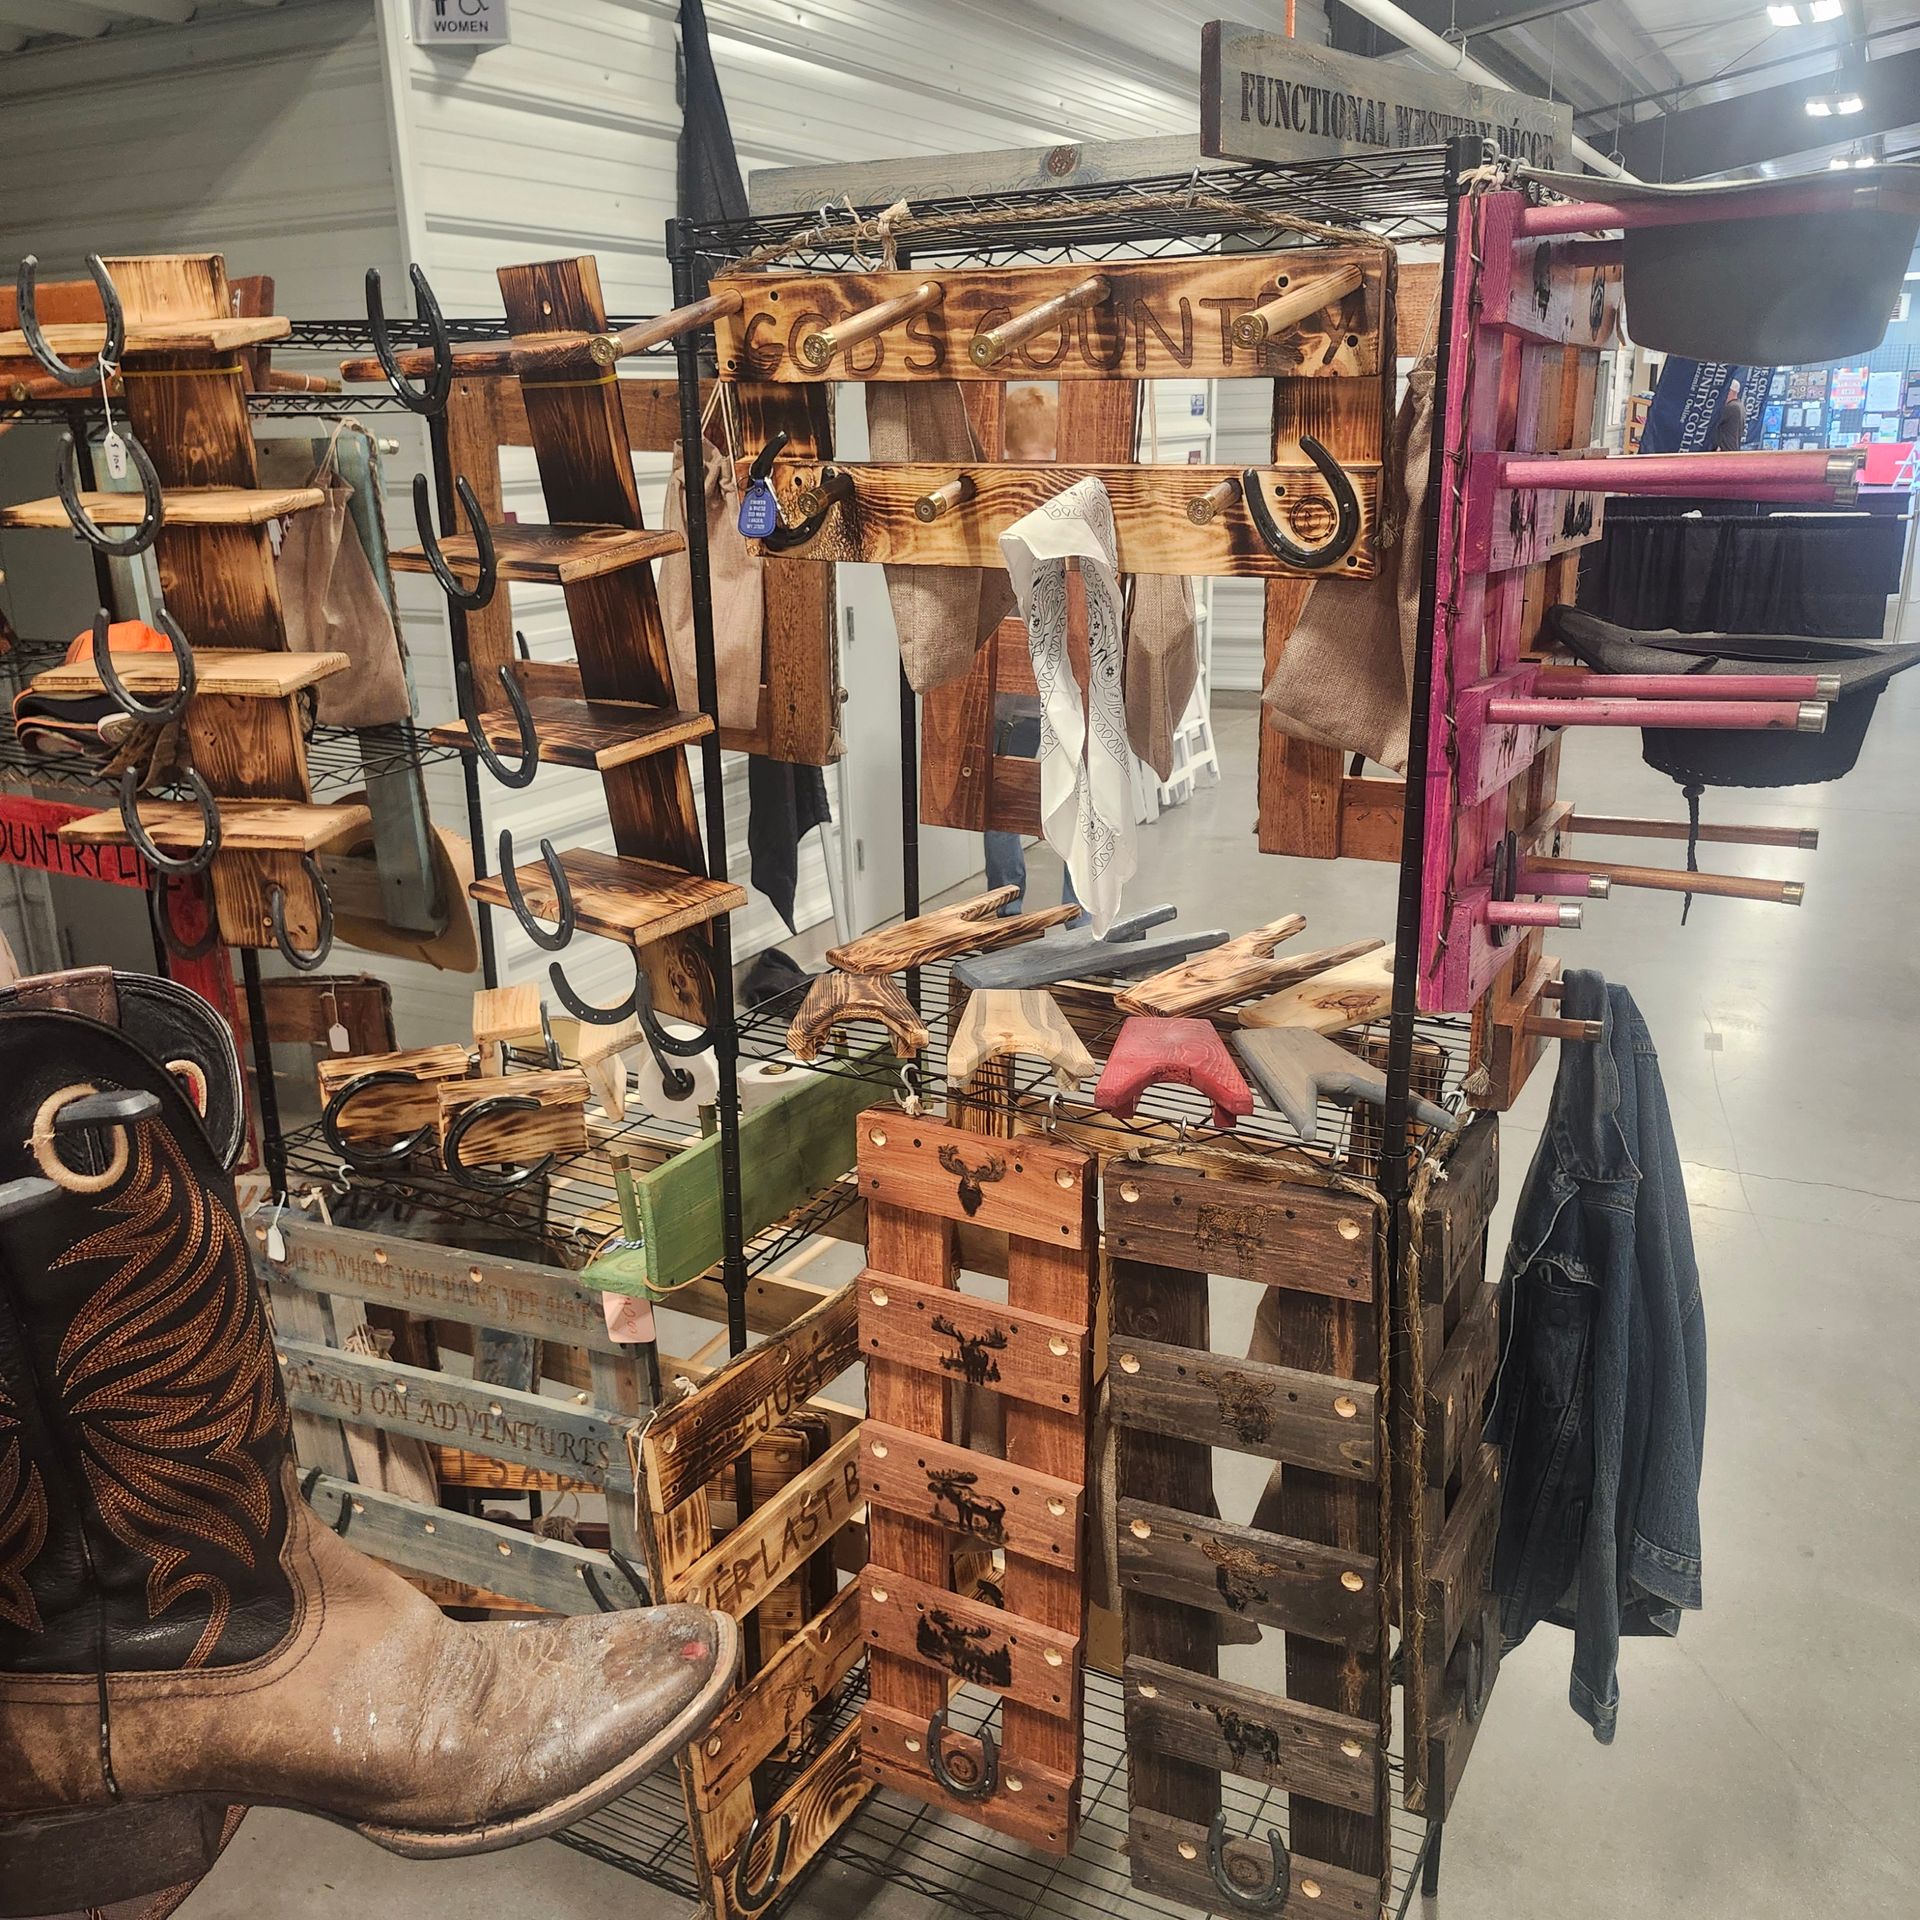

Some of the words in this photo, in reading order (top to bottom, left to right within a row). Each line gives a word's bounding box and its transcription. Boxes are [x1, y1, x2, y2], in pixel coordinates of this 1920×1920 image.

[434, 20, 489, 32] WOMEN
[1241, 71, 1391, 146] FUNCTIONAL
[743, 309, 946, 376] GODS
[1693, 389, 1720, 447] COUNTY
[331, 1249, 396, 1291] WHERE
[399, 1267, 439, 1300] YOU
[370, 1381, 409, 1421] ON
[417, 1398, 610, 1470] ADVENTURES
[760, 1478, 836, 1581] LAST
